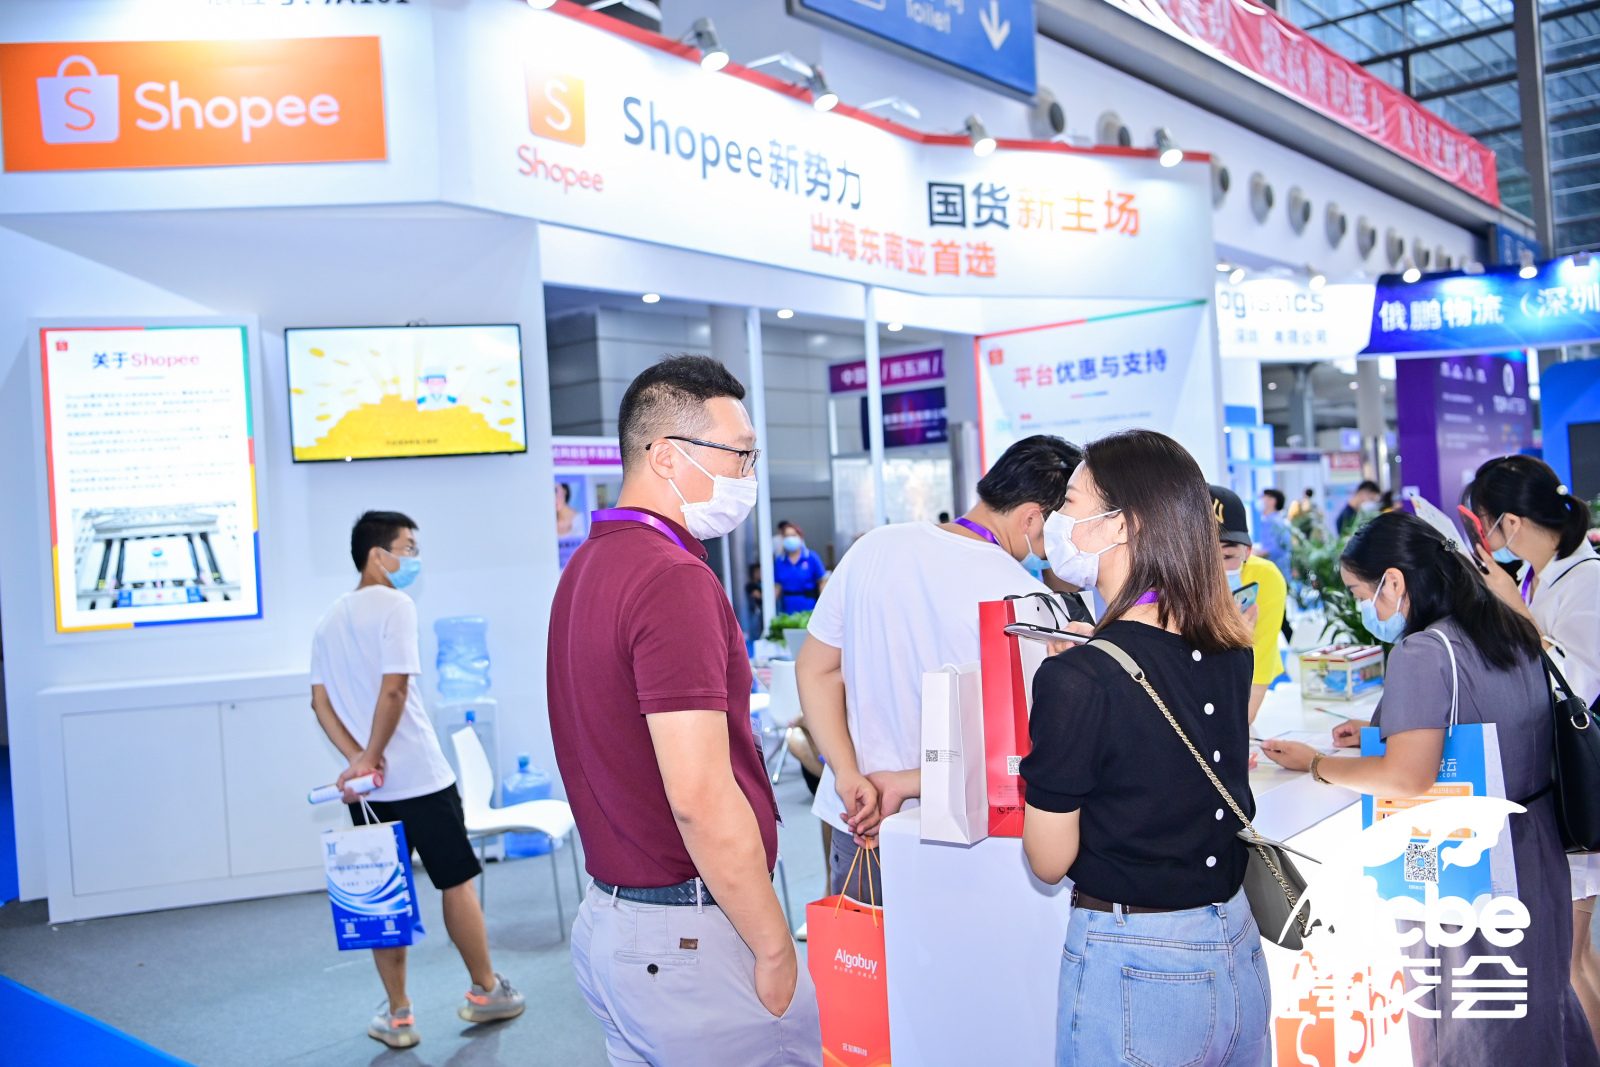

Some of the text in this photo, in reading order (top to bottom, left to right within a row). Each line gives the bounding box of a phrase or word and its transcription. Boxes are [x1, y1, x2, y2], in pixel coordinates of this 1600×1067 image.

[134, 81, 340, 143] Shopee
[517, 144, 604, 194] Shopee
[622, 96, 863, 210] Shopee新势力
[927, 180, 1140, 237] 国货新主场
[810, 214, 997, 279] 出海东南亚首选
[1014, 348, 1168, 389] 平台优惠与支持
[834, 948, 878, 974] Algobuy
